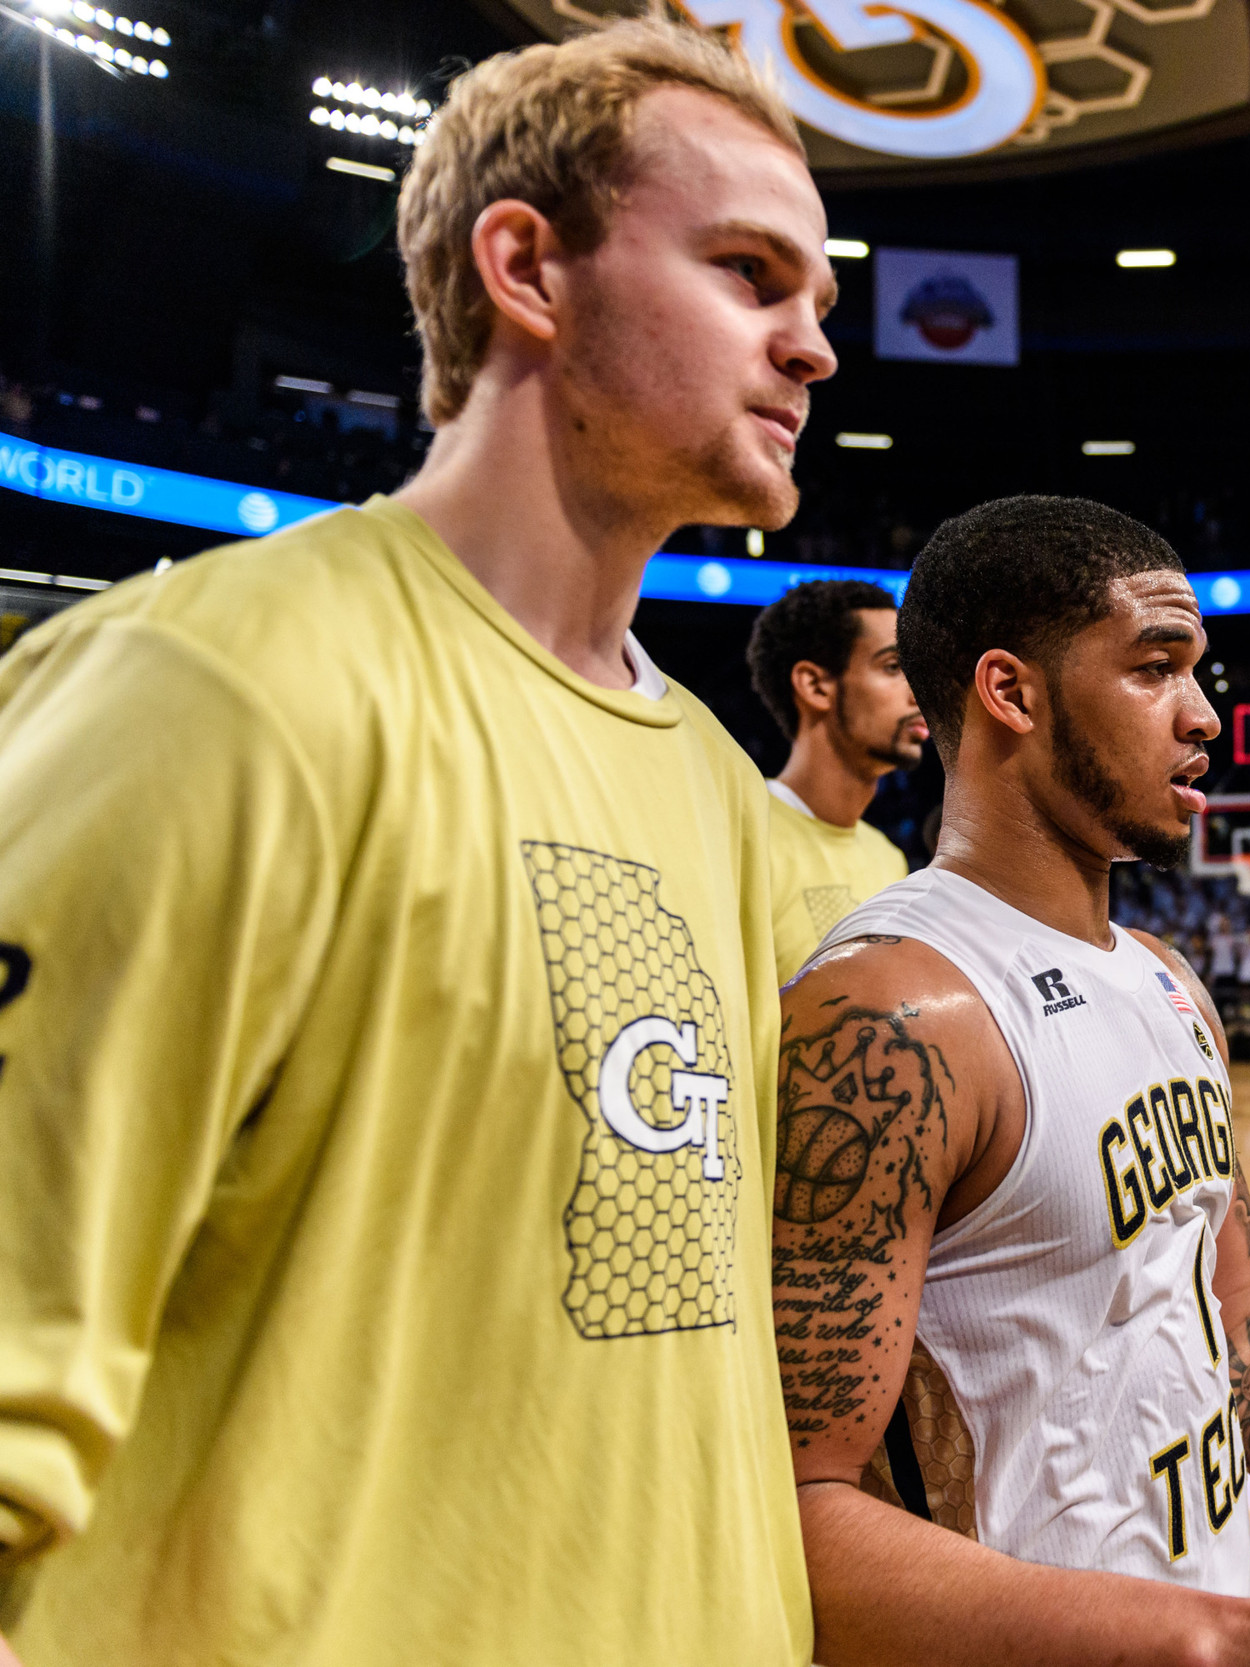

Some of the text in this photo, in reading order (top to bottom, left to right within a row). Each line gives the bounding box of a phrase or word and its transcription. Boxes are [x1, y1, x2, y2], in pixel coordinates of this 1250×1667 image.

[1042, 994, 1087, 1017] RUSSELL
[599, 1014, 729, 1182] GT
[1098, 1076, 1236, 1251] GEORGI
[1149, 1387, 1247, 1564] TEC
